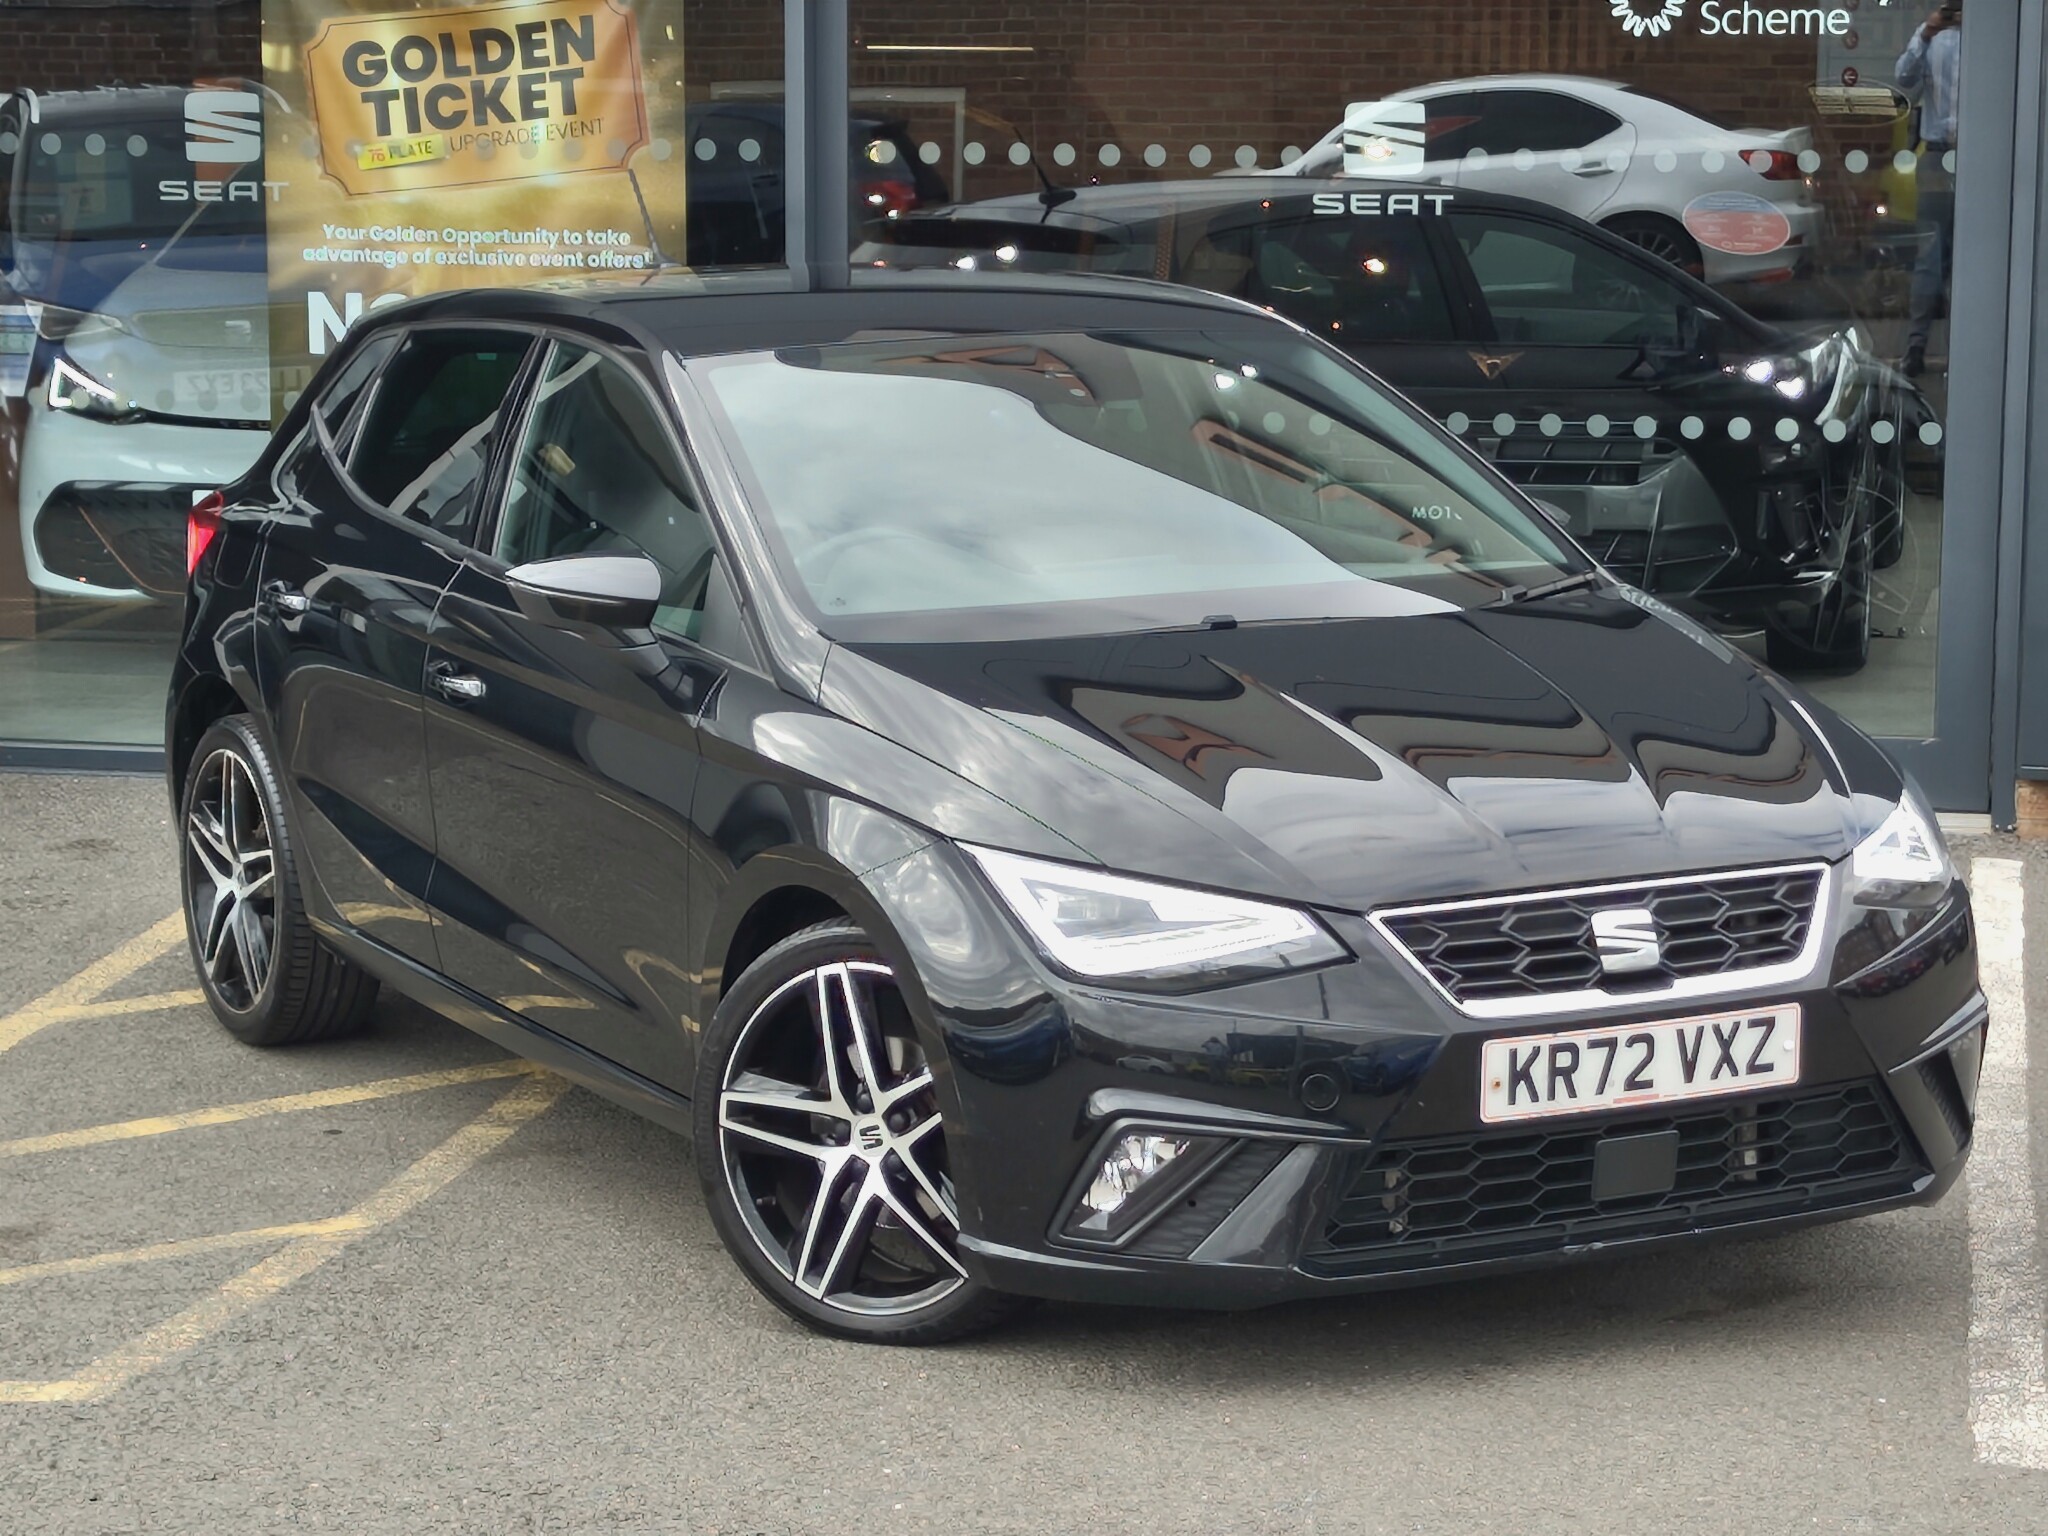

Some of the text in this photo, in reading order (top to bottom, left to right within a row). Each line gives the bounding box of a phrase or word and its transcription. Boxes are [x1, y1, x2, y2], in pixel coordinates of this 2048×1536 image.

[1700, 0, 1850, 35] Scheme
[343, 15, 595, 87] GOLDEN
[361, 67, 584, 136] TICKET
[450, 118, 604, 152] UPGRADE EVENT
[158, 180, 290, 201] SEAT
[1312, 193, 1454, 216] SEAT
[322, 223, 631, 250] Your Golden Opportunity to take
[302, 246, 409, 269] advantage
[412, 247, 431, 265] of
[434, 249, 527, 267] exclusive
[529, 251, 584, 268] event
[1507, 1016, 1776, 1106] KR72 VXZ
